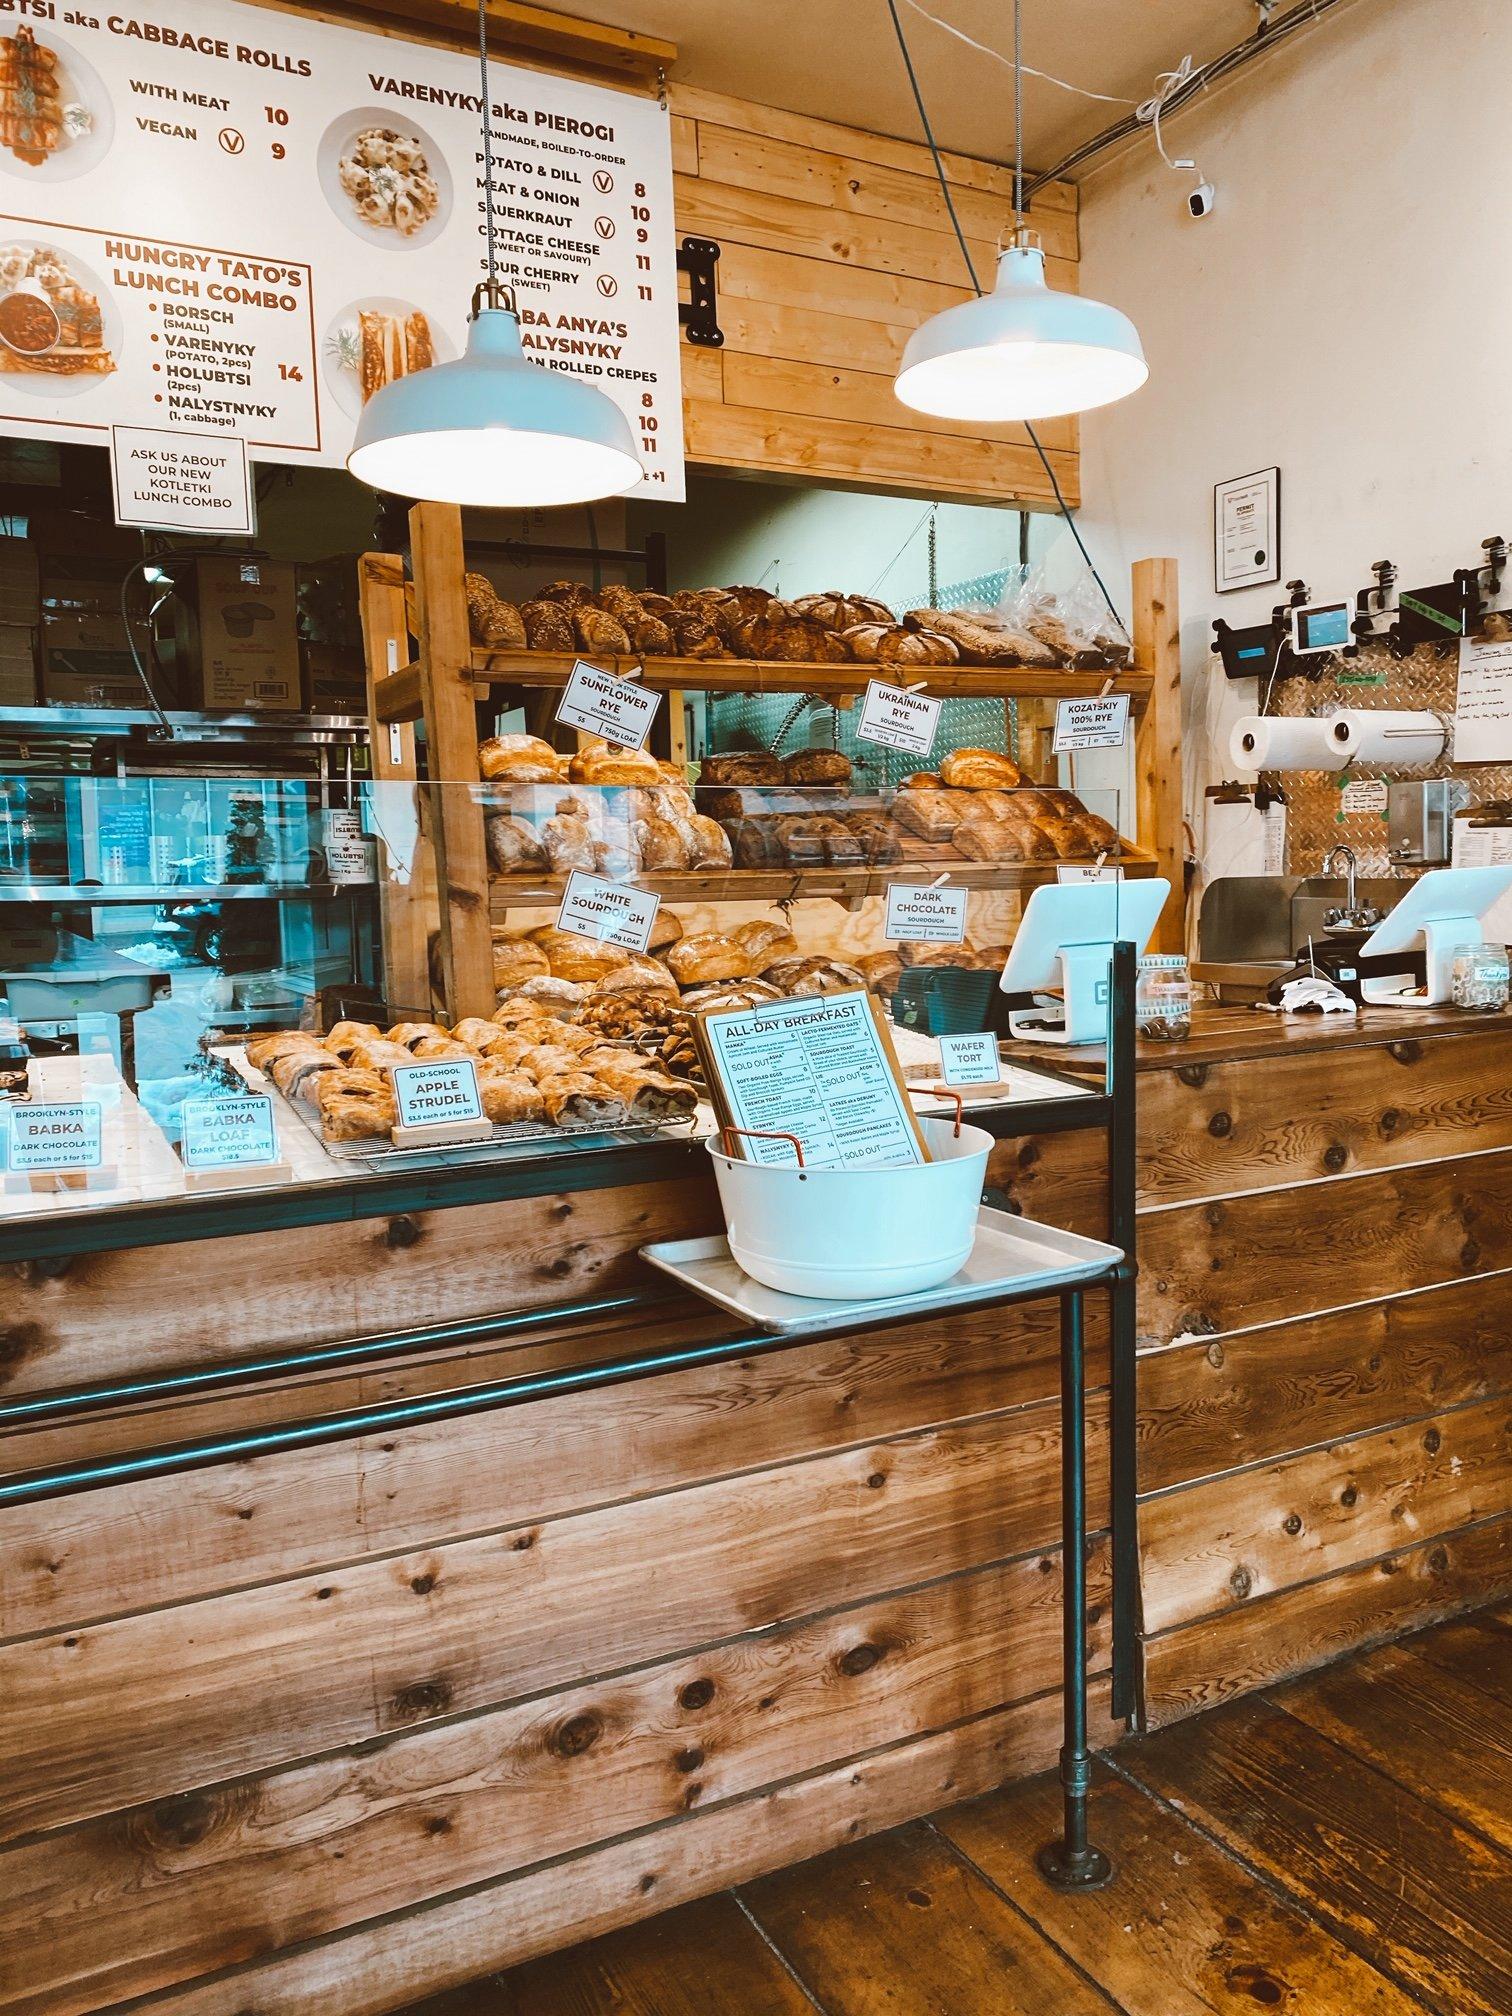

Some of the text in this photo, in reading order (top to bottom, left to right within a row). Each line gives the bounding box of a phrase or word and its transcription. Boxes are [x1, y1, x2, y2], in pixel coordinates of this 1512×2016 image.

[0, 0, 312, 76] BTSI aka CABBAGE ROLLS
[129, 79, 289, 126] WITH MEAT 10
[368, 74, 614, 142] VARENYKY aka PIEROGI
[136, 117, 286, 160] VEGAN 9
[541, 141, 626, 165] BOILED-TO-ORDER
[475, 152, 646, 198] POTATO & DILL 8
[476, 177, 650, 222] MEAT & ONION 10
[477, 201, 648, 244] SAUERKRAUT 9
[478, 225, 651, 271] COTTAGE CHEESE 11
[105, 240, 301, 287] HUNGRY TATO'S
[528, 248, 541, 256] OR
[543, 251, 591, 266] SAVOURY)
[480, 259, 652, 301] SOUR CHERRY 11
[511, 278, 551, 292] (SWEET)
[114, 269, 297, 312] LUNCH COMBO
[163, 303, 234, 324] BORSCH
[164, 319, 210, 334] (SMALL)
[522, 309, 628, 338] BA ANYA'S
[164, 334, 256, 357] VARENYKY
[522, 333, 622, 360] ALYSNYKY
[166, 350, 251, 370] (POTATO, 2pcs)
[167, 364, 303, 386] HOLUBTSI 14
[550, 359, 602, 375] ROLLED
[607, 367, 657, 383] CREPES
[168, 381, 201, 393] (2pcs)
[169, 395, 277, 418] NALYSTNYKY
[642, 393, 653, 407] 8
[170, 411, 236, 427] (1, cabbage)
[639, 416, 657, 431] 10
[642, 438, 656, 452] 11
[131, 449, 226, 467] ASK US ABOUT
[148, 465, 211, 480] OUR NEW
[652, 471, 665, 483] +1
[150, 479, 211, 493] KOTLETKI
[134, 491, 232, 508] LUNCH COMBO
[579, 677, 648, 711] SUNFLOWER
[600, 699, 621, 714] RYE
[892, 708, 910, 720] RYE
[1068, 702, 1118, 713] KOZATSKIY
[590, 707, 621, 722] SOURDOUGH
[1071, 714, 1112, 724] 100% RYE
[880, 717, 914, 731] SOURDOUGH
[1073, 725, 1106, 733] SOURDOUGH
[620, 733, 637, 744] LOAF
[594, 887, 631, 907] WHITE
[914, 893, 941, 902] DARK
[572, 896, 644, 924] SOURDOUGH
[897, 904, 956, 914] CHOCOLATE
[726, 1006, 856, 1038] ALL-DAY BREAKFAST
[951, 1042, 985, 1051] WAFER
[731, 1061, 753, 1072] SOLD
[754, 1058, 769, 1068] OUT
[957, 1054, 982, 1063] TORT
[409, 1068, 460, 1079] OLD-SCHOOL
[826, 1075, 846, 1086] SOLD
[846, 1071, 861, 1081] OUT
[416, 1081, 459, 1093] APPLE
[409, 1094, 470, 1109] STRUDEL
[16, 1109, 96, 1118] BROOKLYN-STYLE
[203, 1114, 255, 1127] BABKA
[29, 1124, 83, 1135] BABKA
[867, 1122, 892, 1132] PANCAKES
[210, 1130, 249, 1142] LOAF
[14, 1141, 97, 1151] DARK CHOCOLATE
[218, 1142, 270, 1151] CHOCOLATE
[844, 1144, 881, 1160] SOLD OUT
